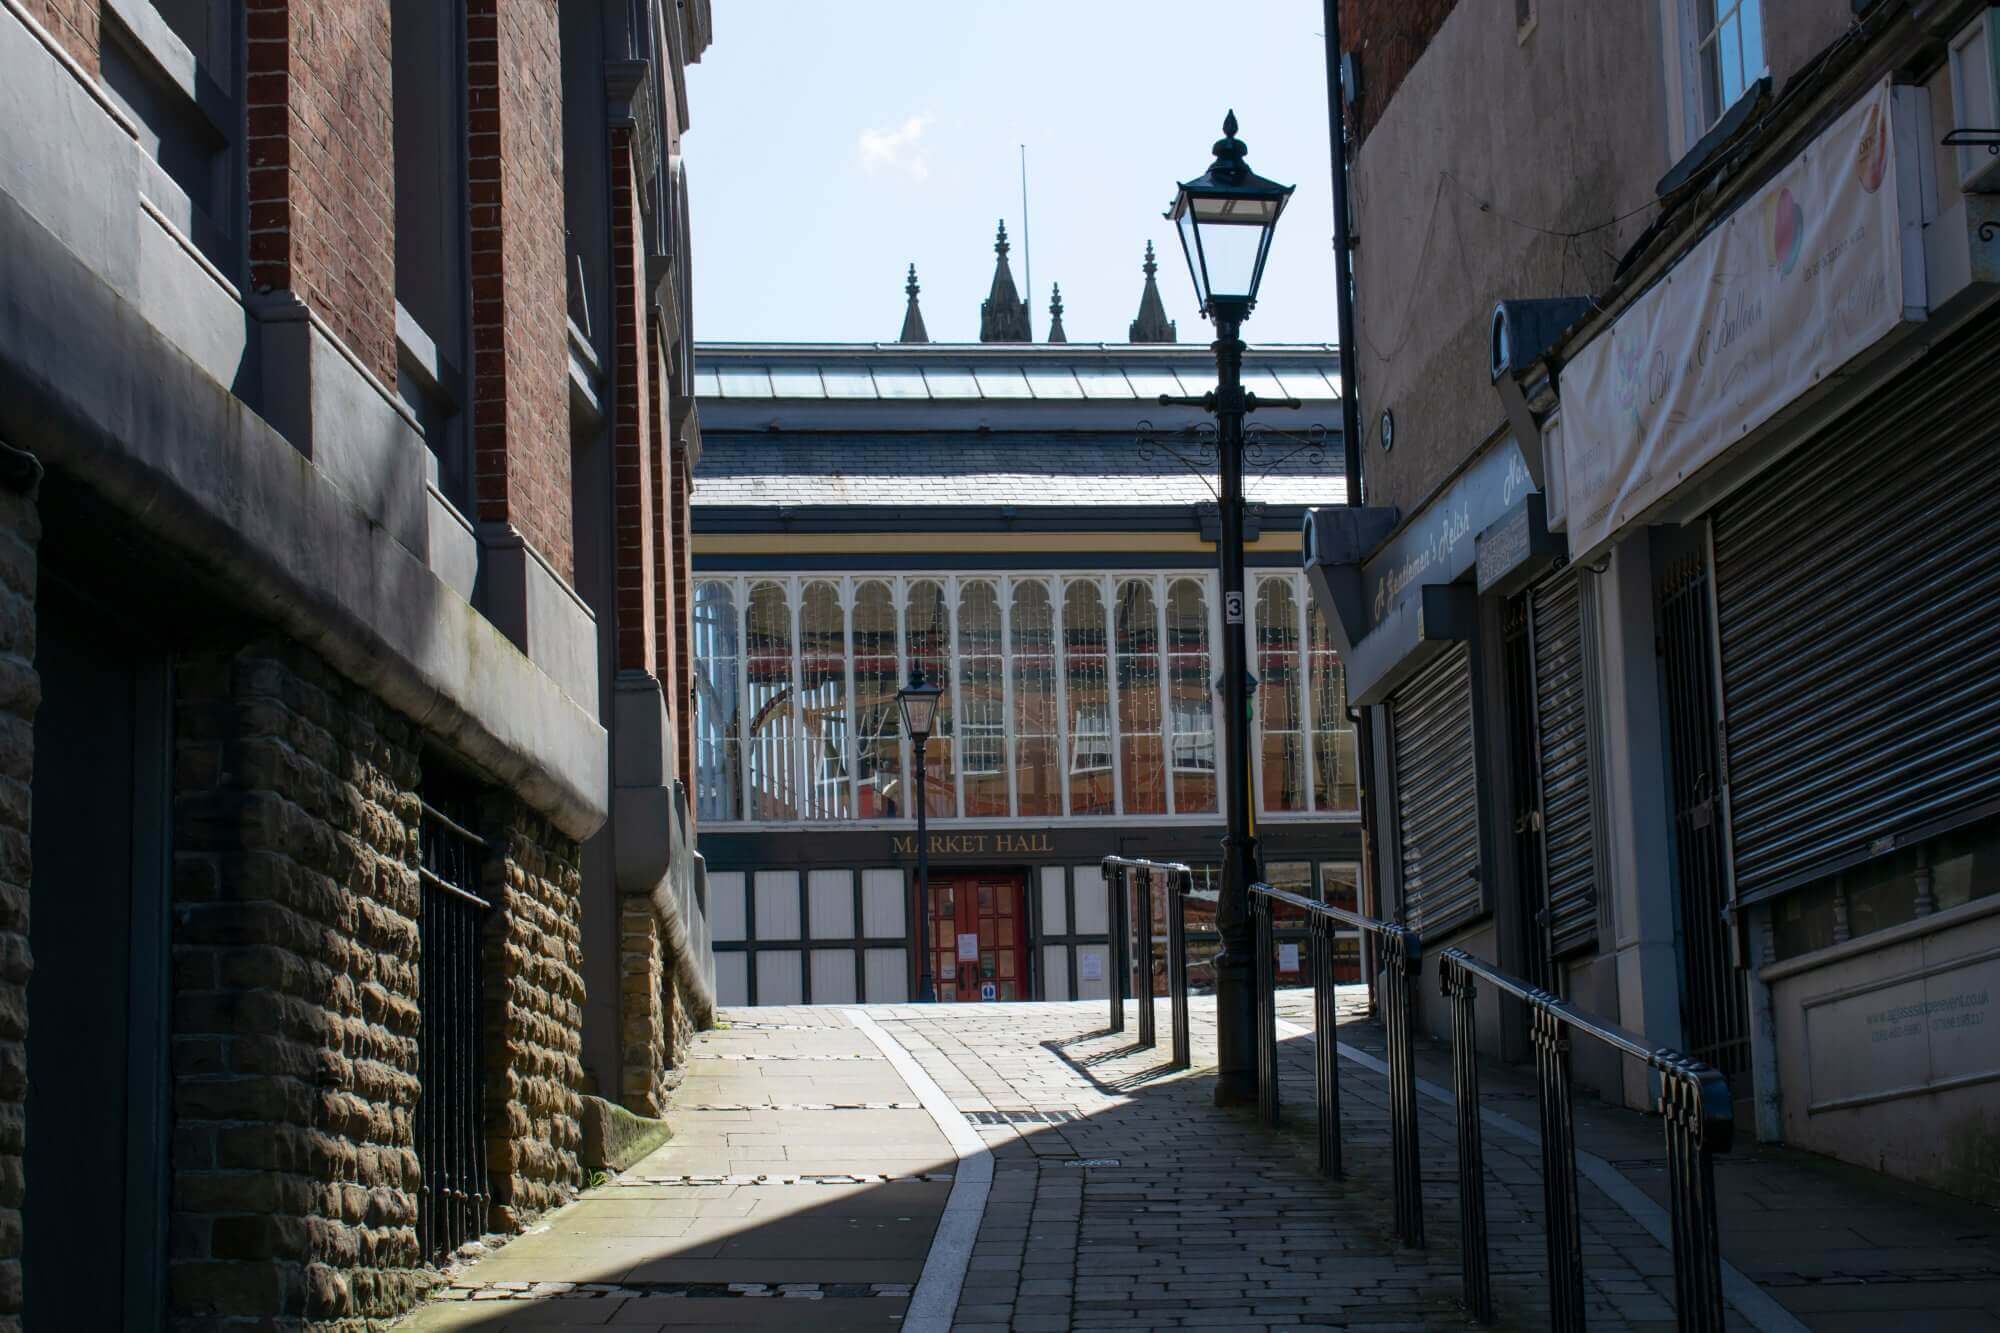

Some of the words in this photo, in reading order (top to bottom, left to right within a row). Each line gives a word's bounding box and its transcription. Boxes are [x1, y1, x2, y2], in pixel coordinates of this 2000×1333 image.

[1374, 577, 1385, 621] A
[1438, 500, 1470, 564] Relish
[1229, 598, 1241, 616] 3
[996, 832, 1054, 853] HALL
